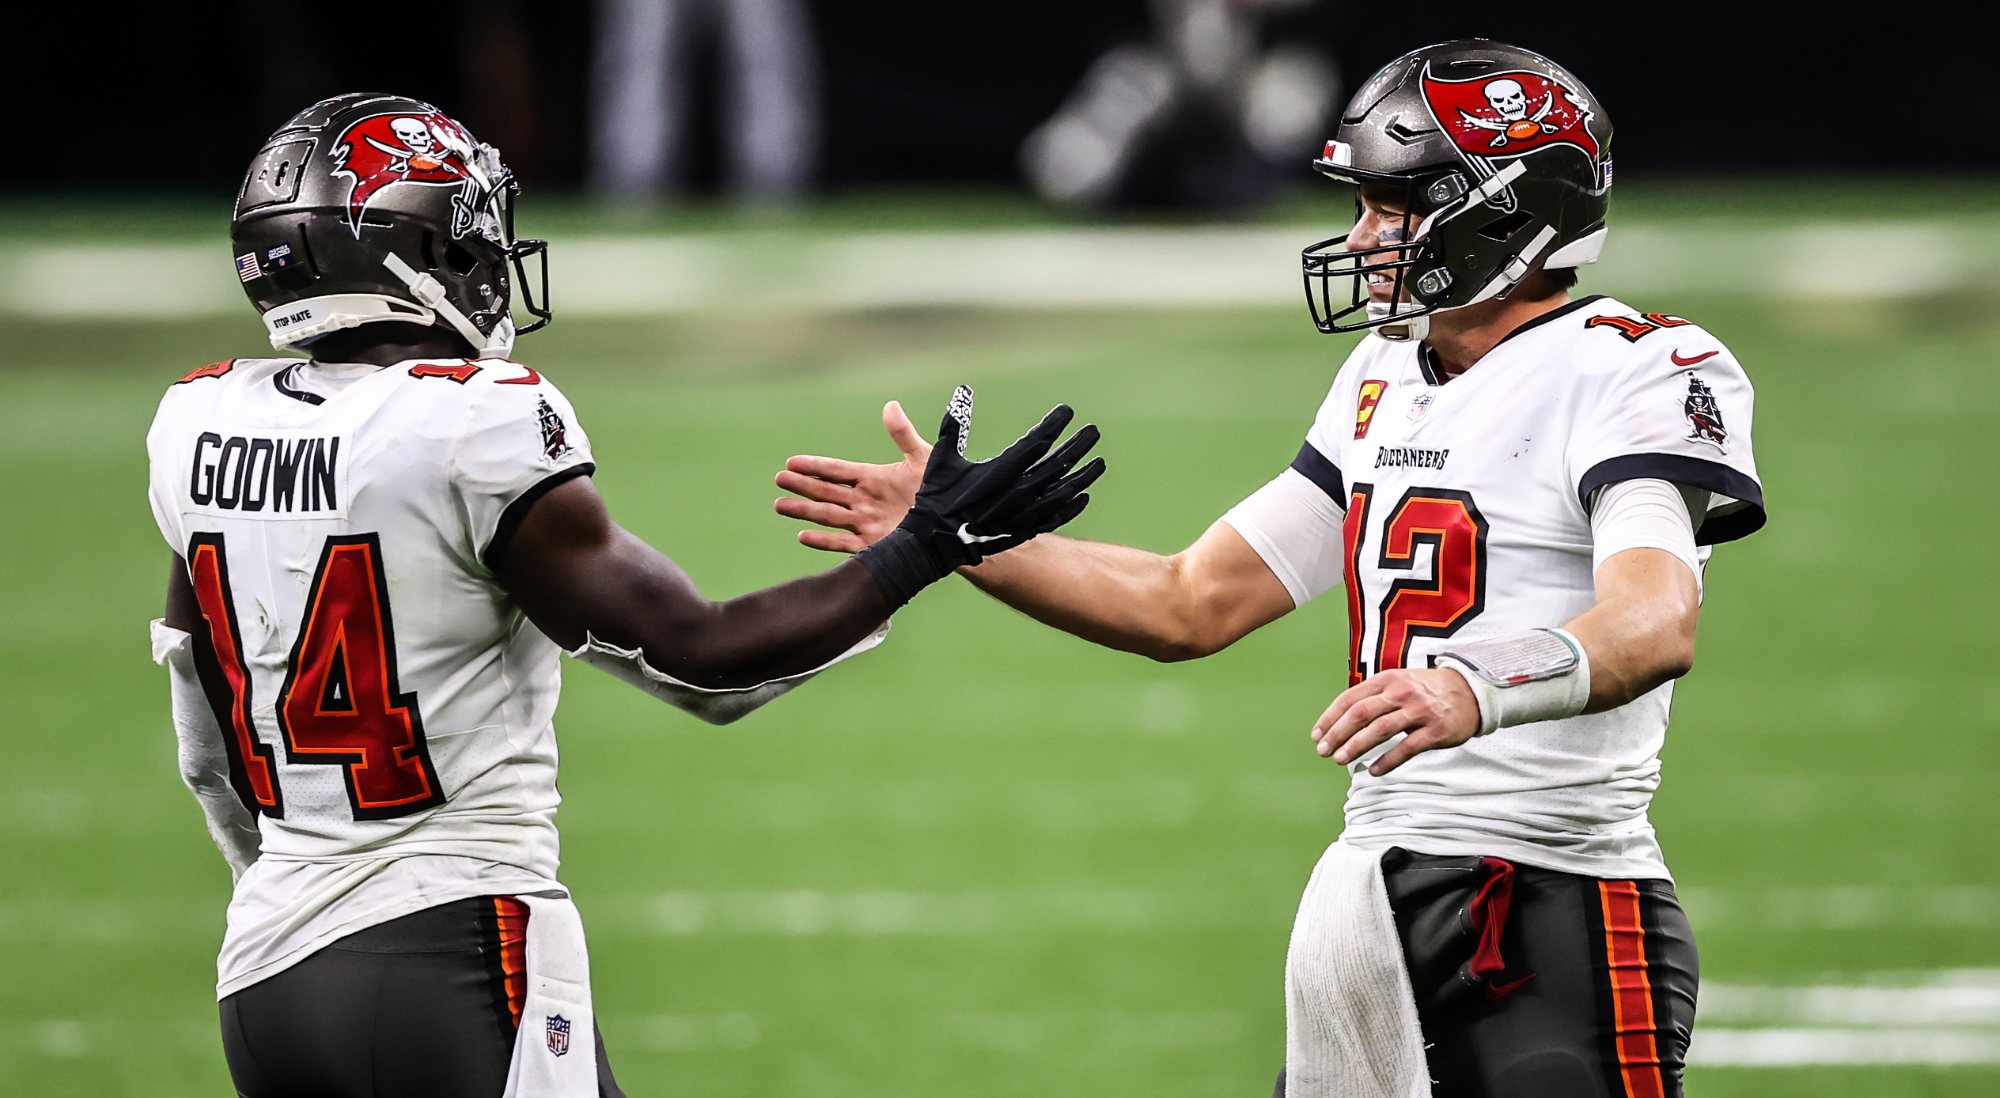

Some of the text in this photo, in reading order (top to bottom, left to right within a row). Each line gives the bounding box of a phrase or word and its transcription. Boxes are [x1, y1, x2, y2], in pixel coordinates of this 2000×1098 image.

[273, 309, 312, 329] STOP HATE
[1357, 383, 1381, 423] C
[191, 432, 339, 512] GODWIN
[1374, 446, 1449, 471] BUCCANEERS
[1342, 482, 1489, 687] 12
[187, 531, 447, 821] 14
[548, 1031, 568, 1052] NFL
